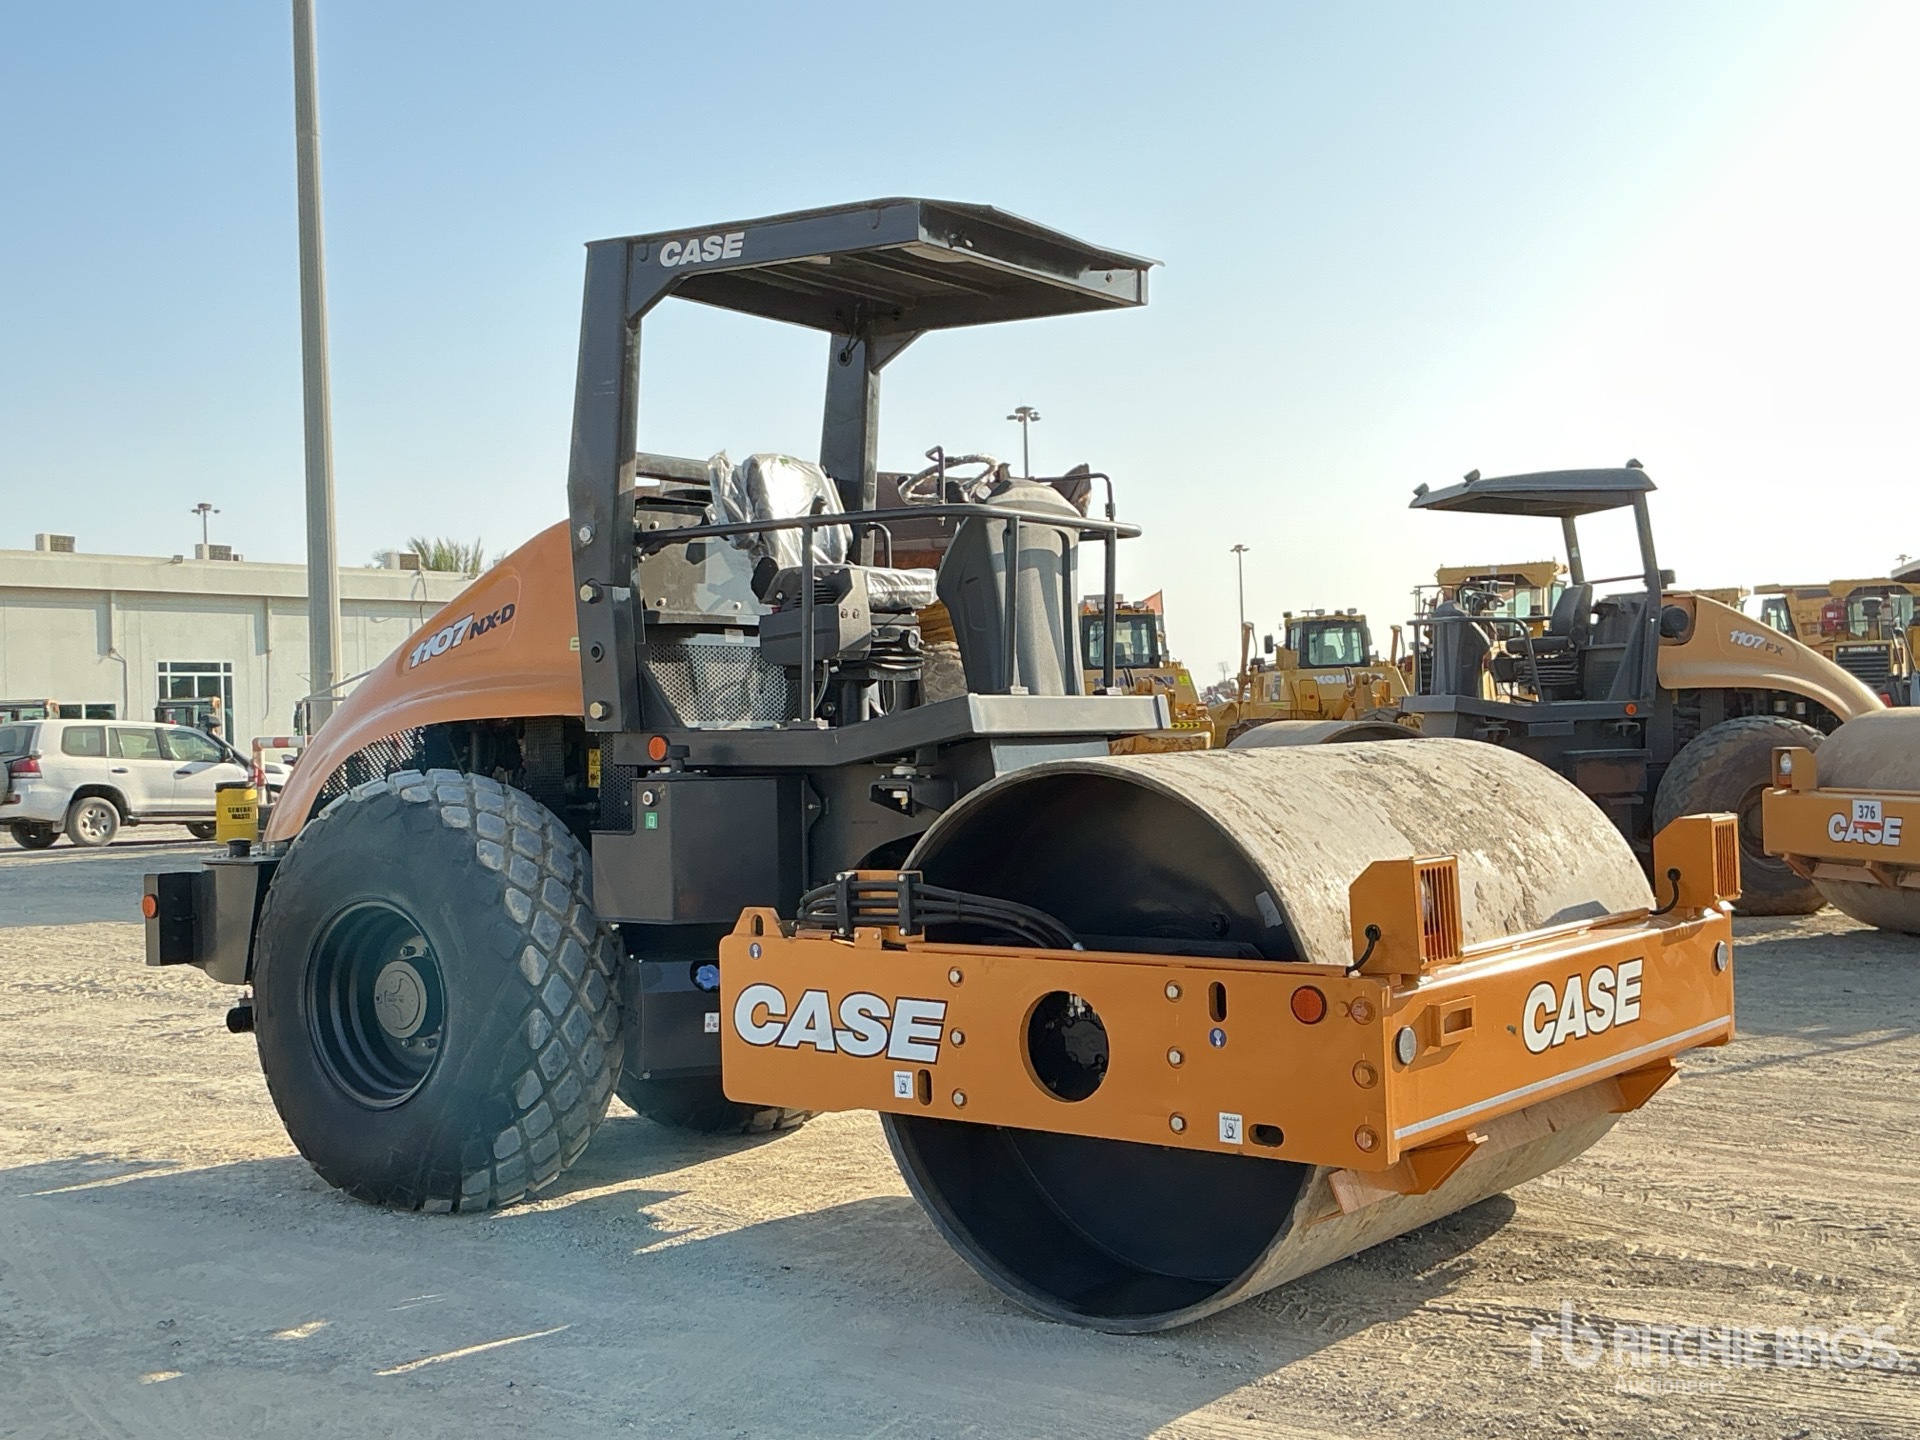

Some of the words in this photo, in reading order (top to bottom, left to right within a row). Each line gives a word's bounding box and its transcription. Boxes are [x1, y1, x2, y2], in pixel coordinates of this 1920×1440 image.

[659, 231, 745, 267] CASE
[410, 612, 475, 669] 1107
[469, 603, 516, 640] NX-D
[1729, 629, 1766, 649] 1107
[1765, 643, 1783, 656] FX
[1858, 805, 1876, 819] 376
[733, 983, 948, 1065] CASE
[1522, 957, 1644, 1055] CASE
